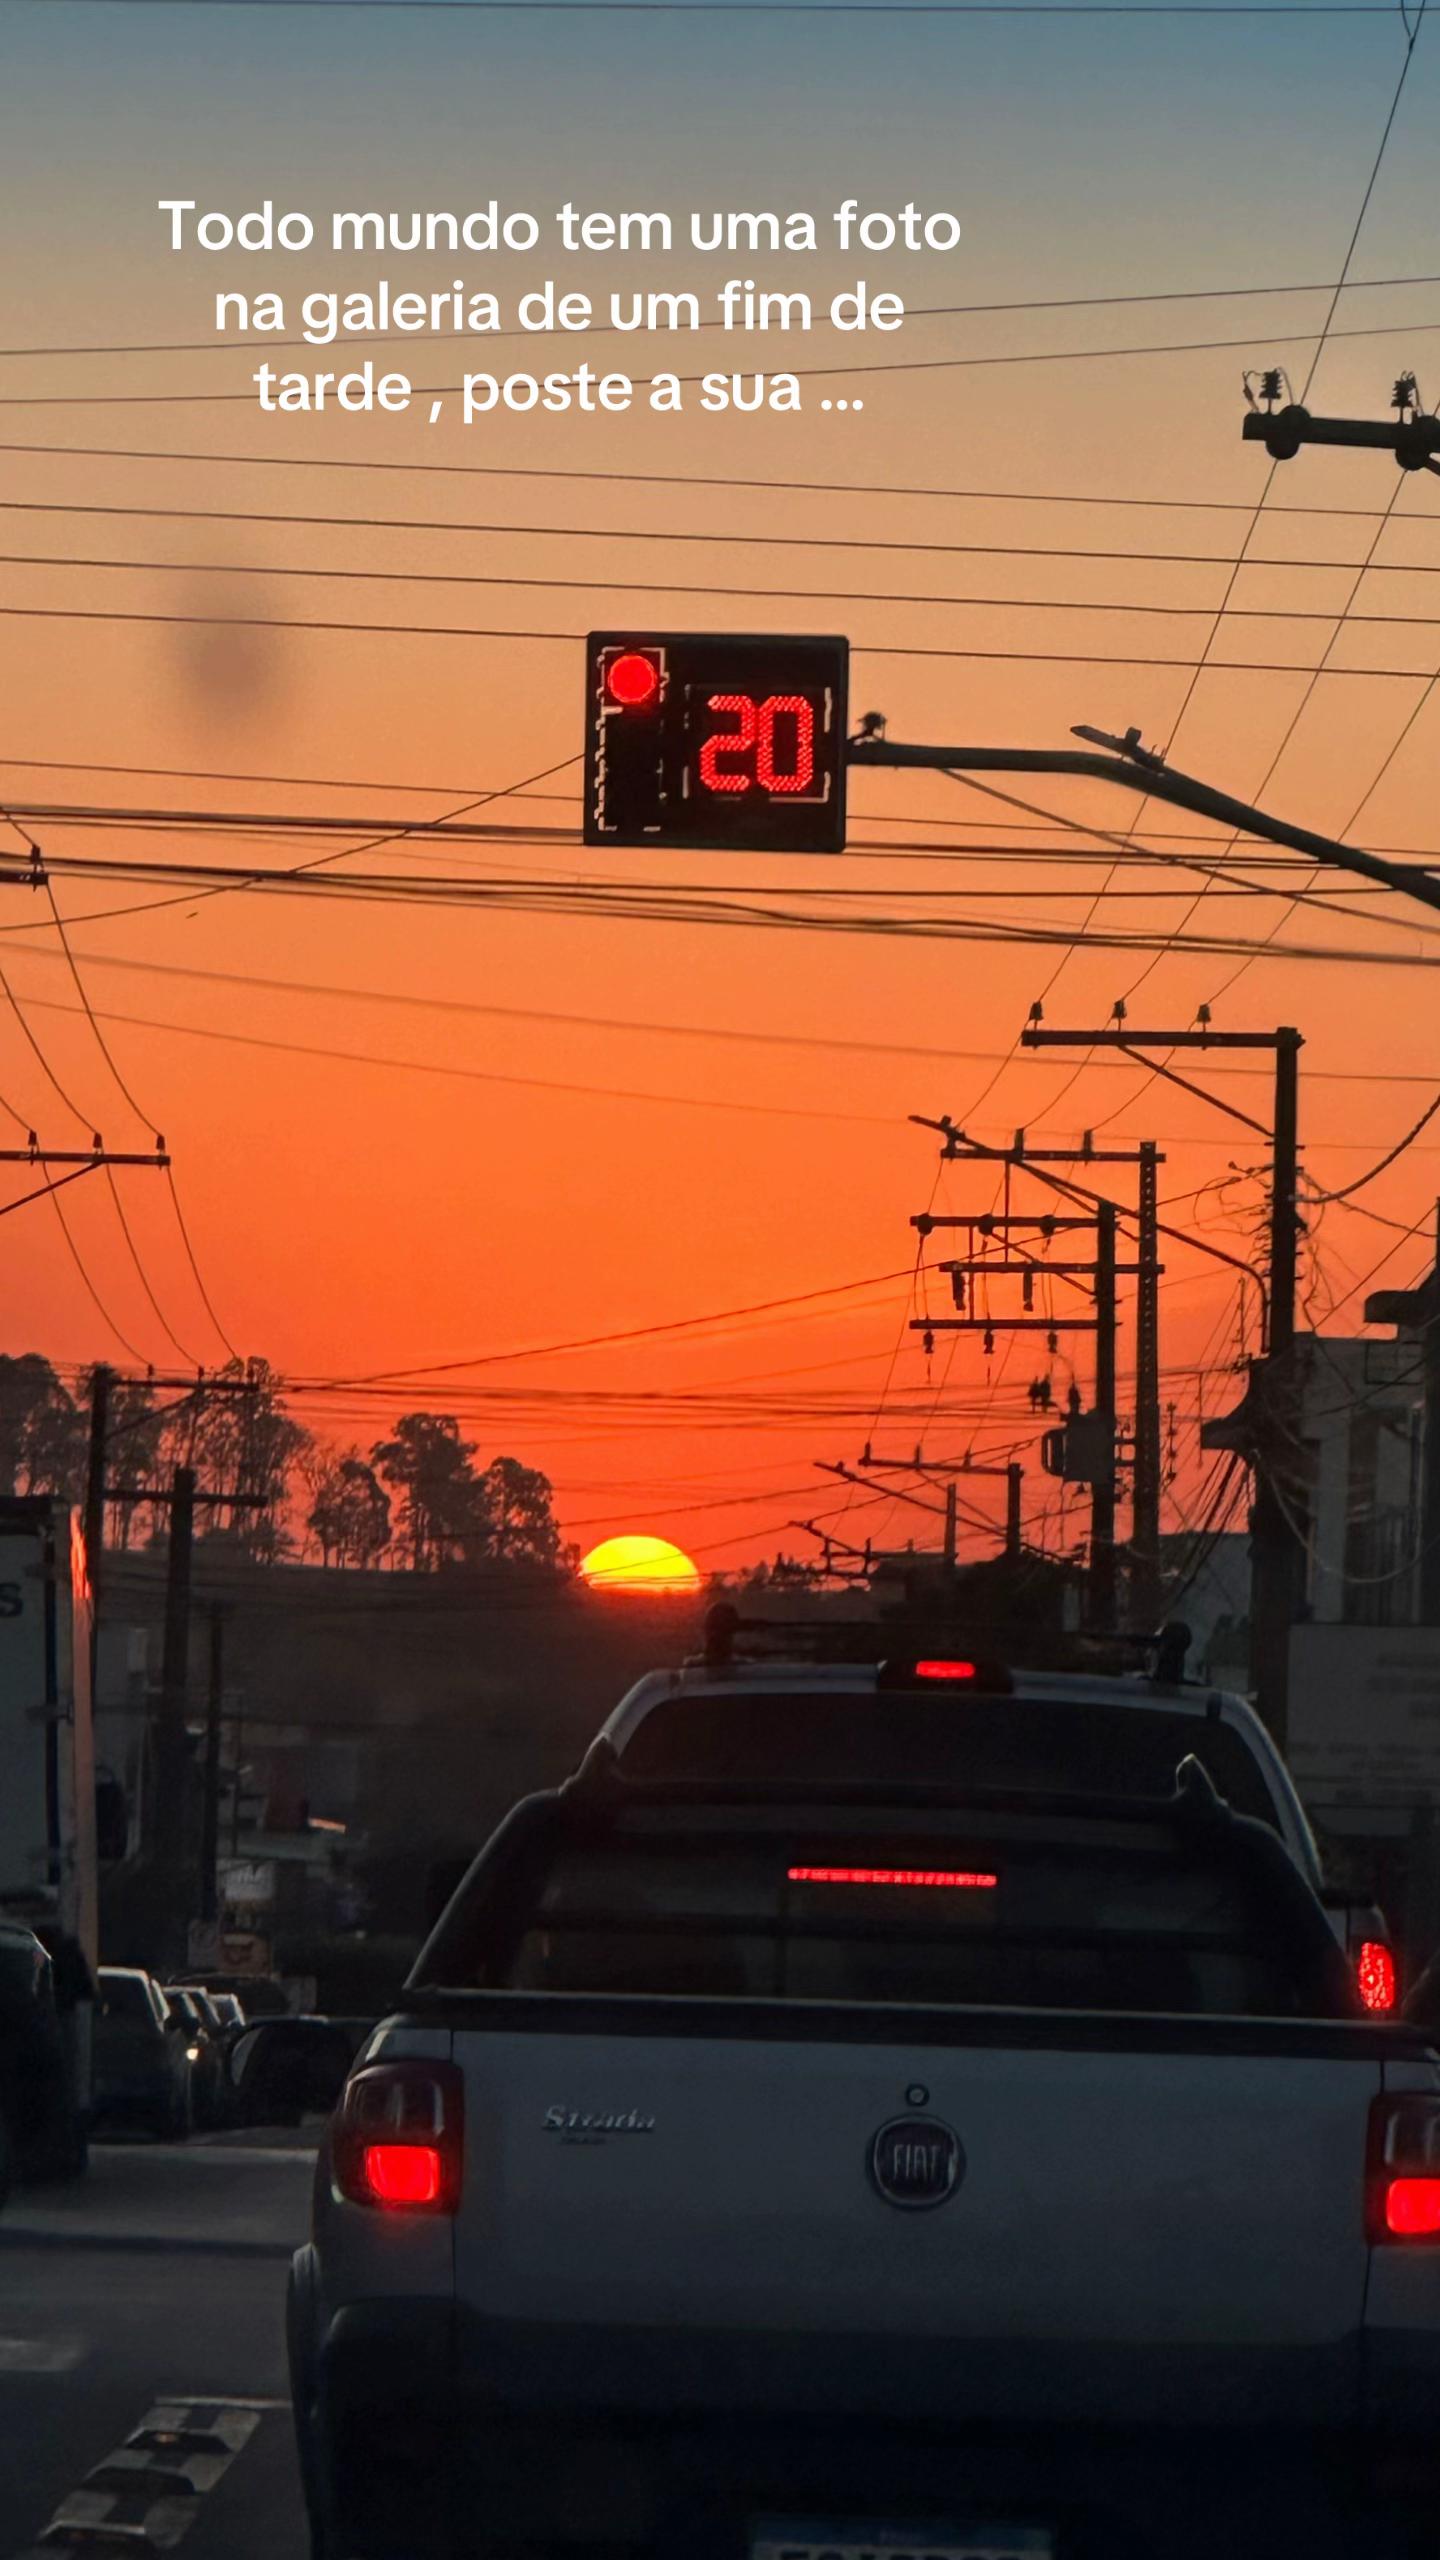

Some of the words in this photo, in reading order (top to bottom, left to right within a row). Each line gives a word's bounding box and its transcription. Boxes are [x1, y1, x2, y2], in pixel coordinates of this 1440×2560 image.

[699, 695, 815, 792] 20
[542, 2104, 656, 2131] Strada
[893, 2143, 942, 2181] FIAT
